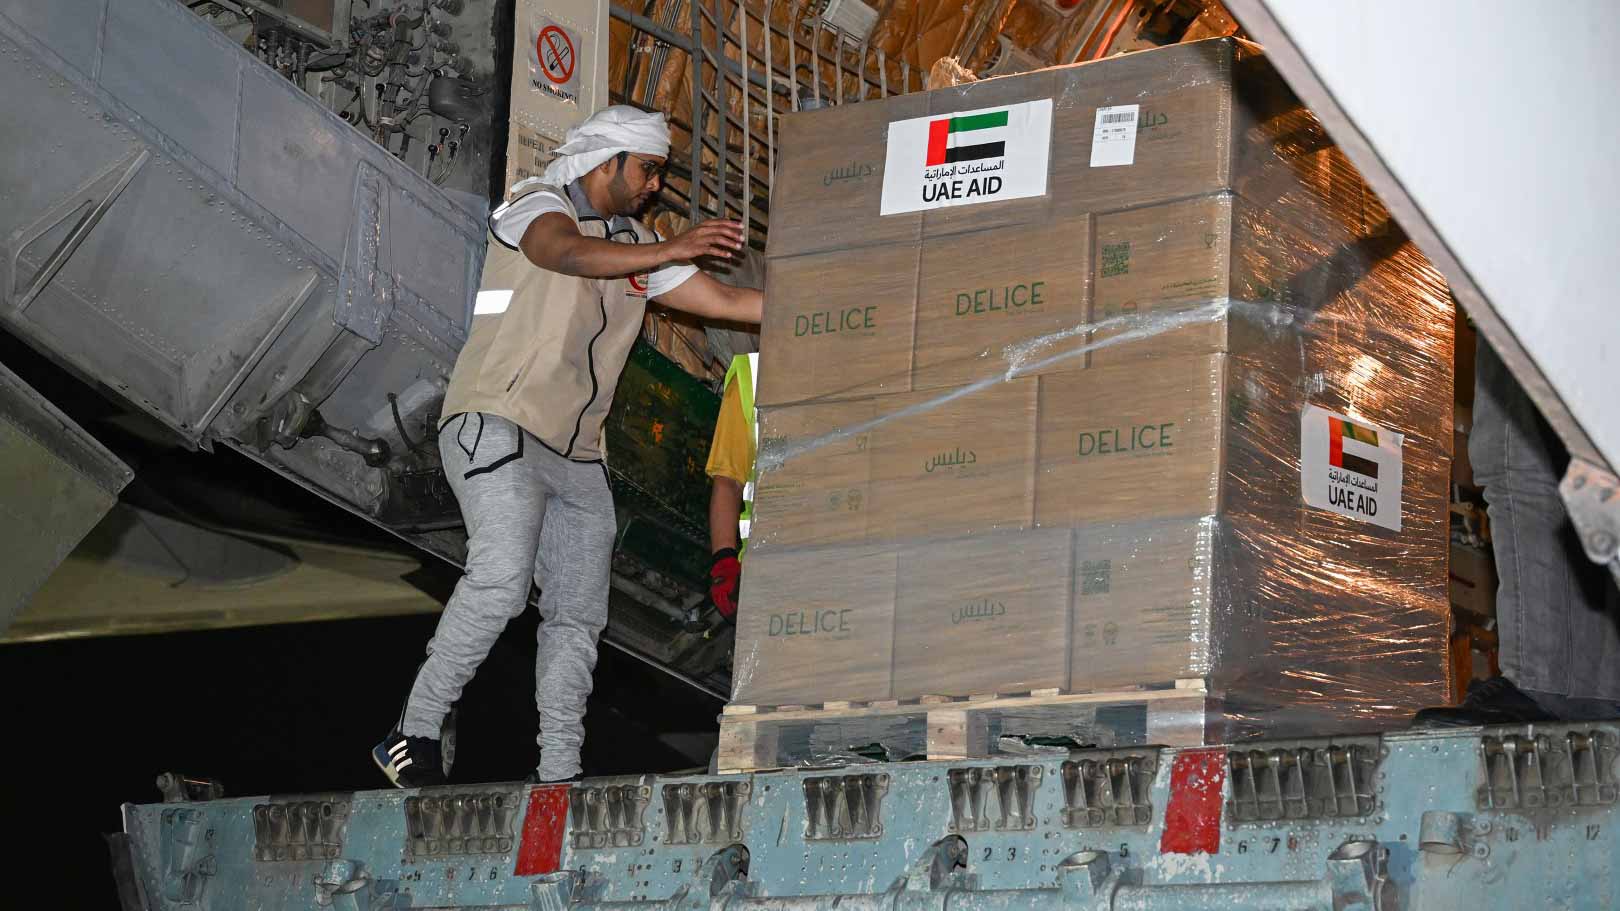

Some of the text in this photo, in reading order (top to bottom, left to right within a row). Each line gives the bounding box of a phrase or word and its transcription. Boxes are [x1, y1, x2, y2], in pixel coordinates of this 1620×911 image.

[530, 79, 542, 89] NO
[924, 160, 1005, 182] المساعدات الإماراتية
[922, 176, 1003, 203] UAE AID
[955, 281, 1045, 316] DELICE
[794, 305, 880, 337] DELICE
[1078, 422, 1175, 456] DELICE
[1350, 476, 1378, 493] المساعدات
[1328, 484, 1378, 517] UAE AID
[768, 608, 853, 637] DELICE
[1120, 843, 1129, 858] 5
[1238, 839, 1248, 855] 6
[1271, 837, 1281, 854] 7
[982, 847, 993, 862] 2
[1007, 847, 1017, 862] 3
[468, 867, 476, 881] 7
[489, 866, 498, 881] 6
